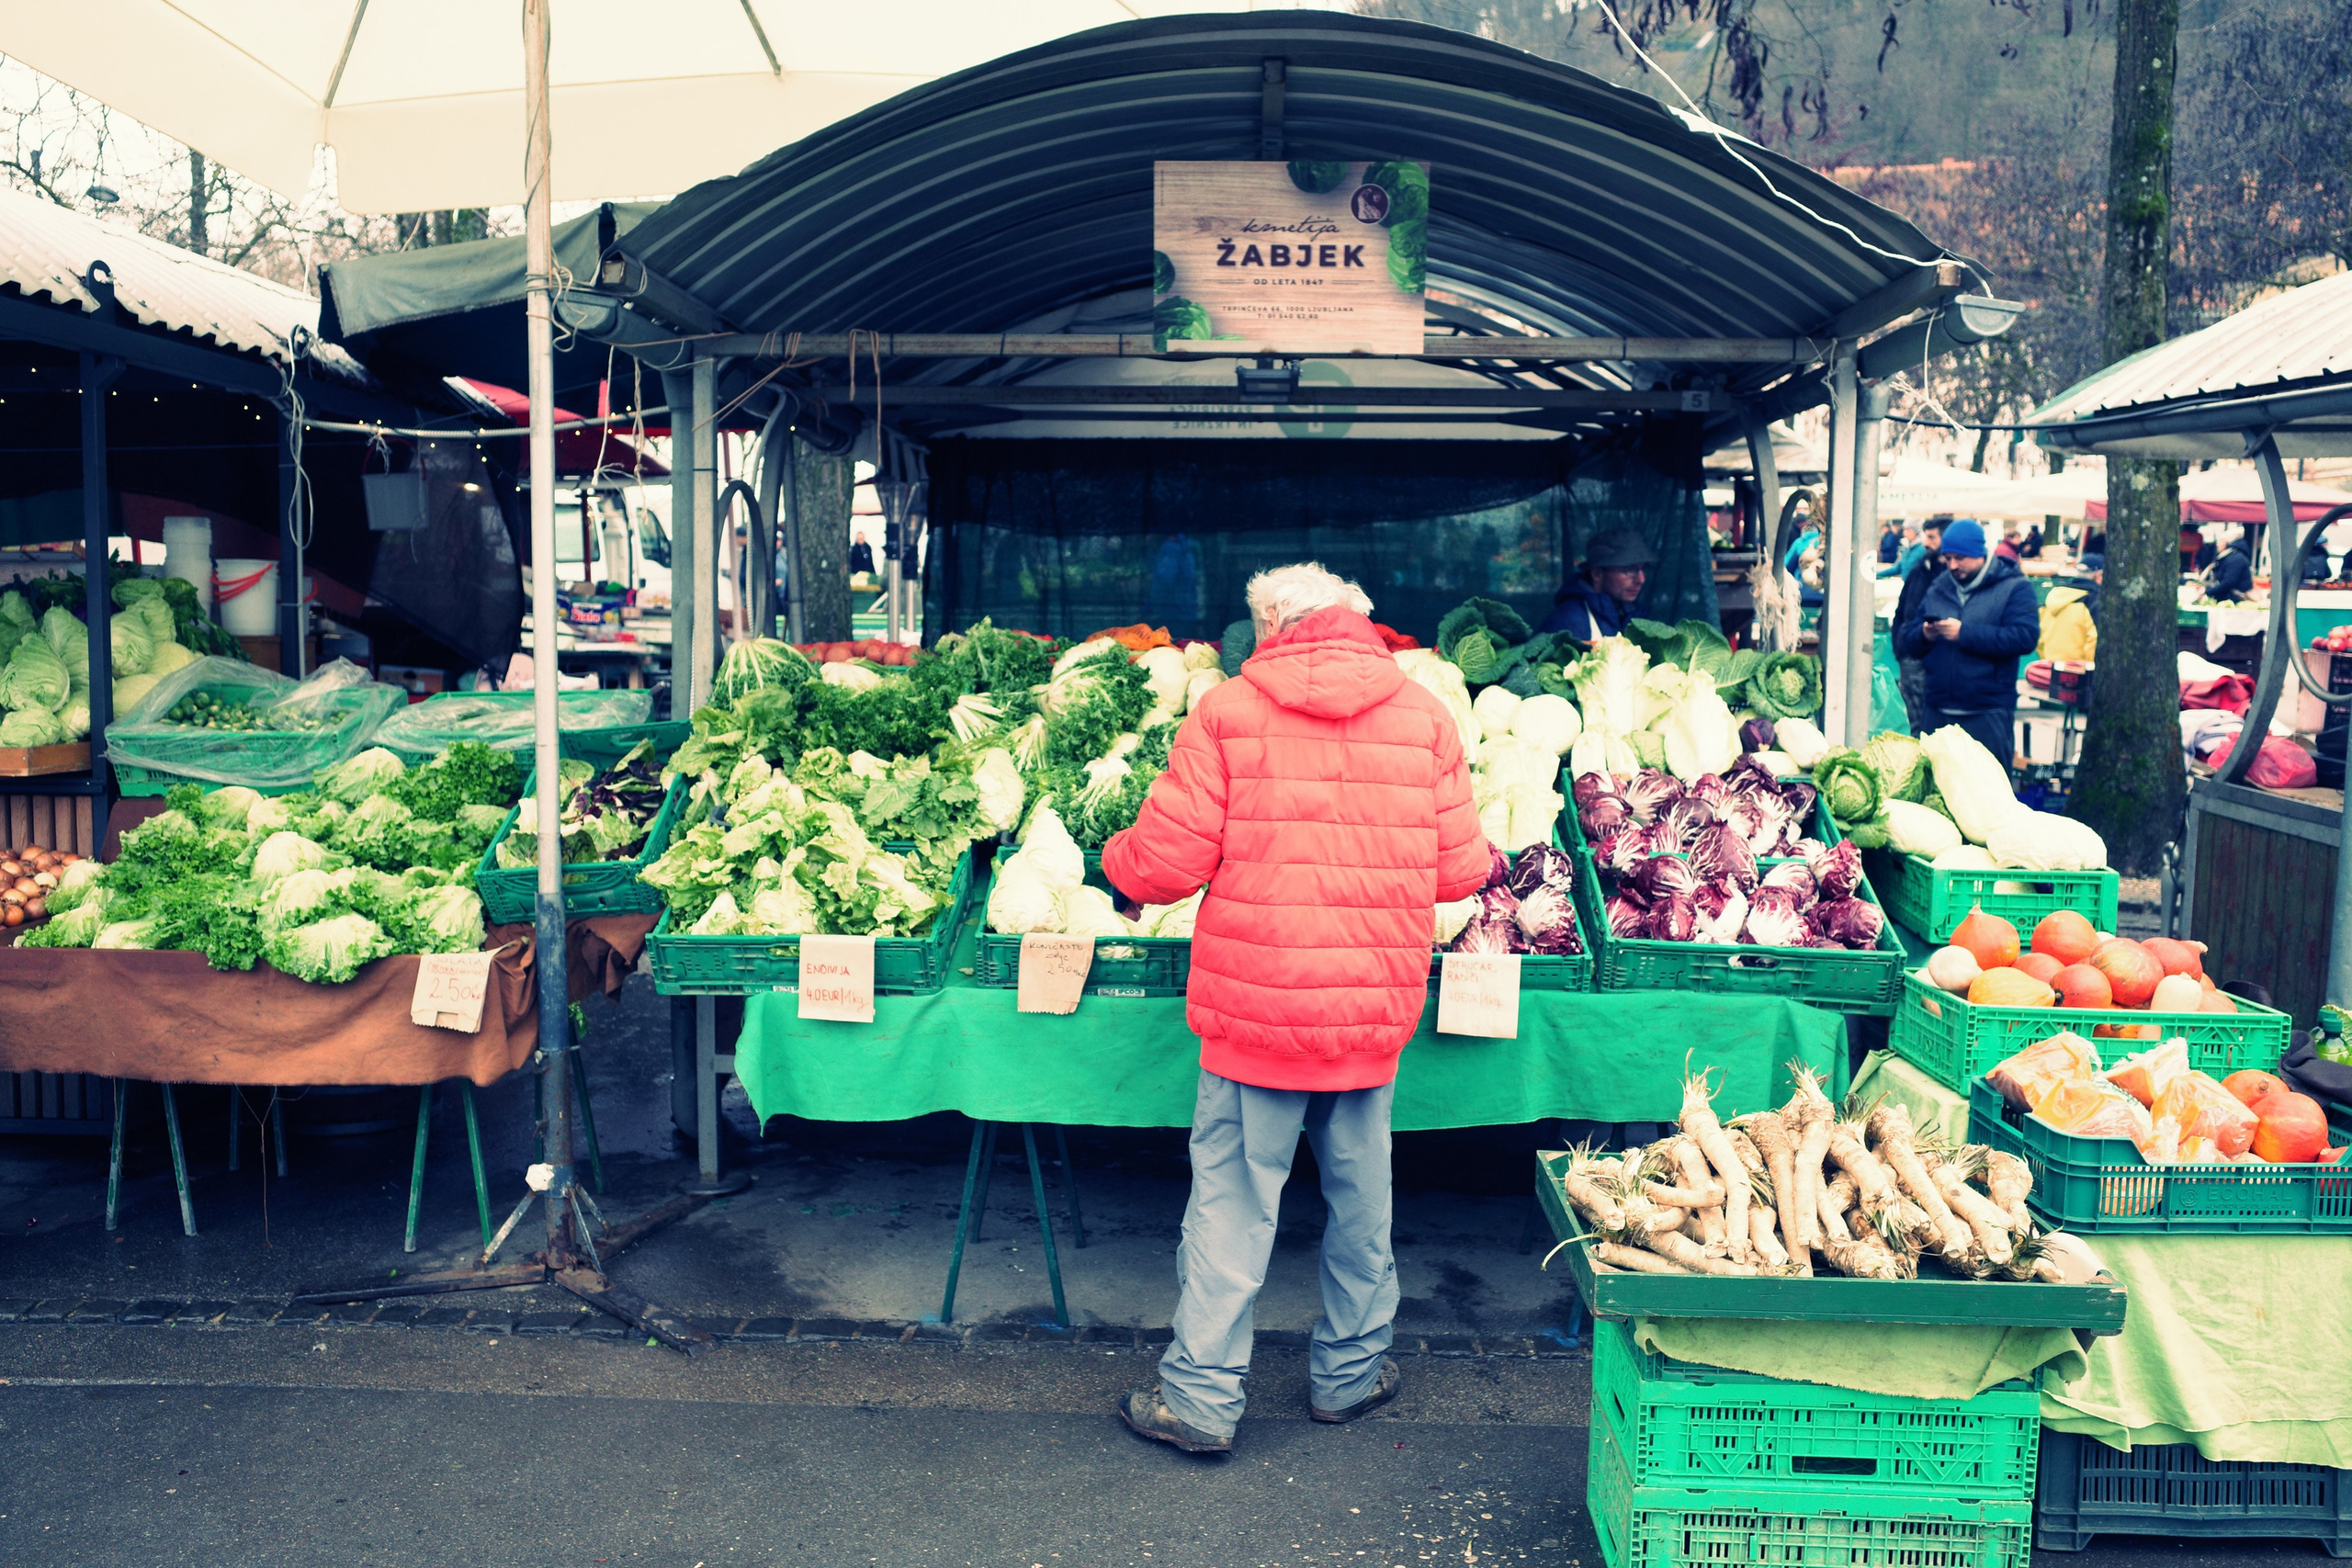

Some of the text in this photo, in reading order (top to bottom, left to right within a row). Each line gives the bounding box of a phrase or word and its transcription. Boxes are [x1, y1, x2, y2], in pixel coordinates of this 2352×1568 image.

[1240, 215, 1340, 243] kmetija
[1216, 237, 1365, 267] ŽABJEK
[1690, 393, 1703, 408] 5
[806, 963, 851, 976] ENDIVIJA
[2207, 1187, 2292, 1201] ECOHAL
